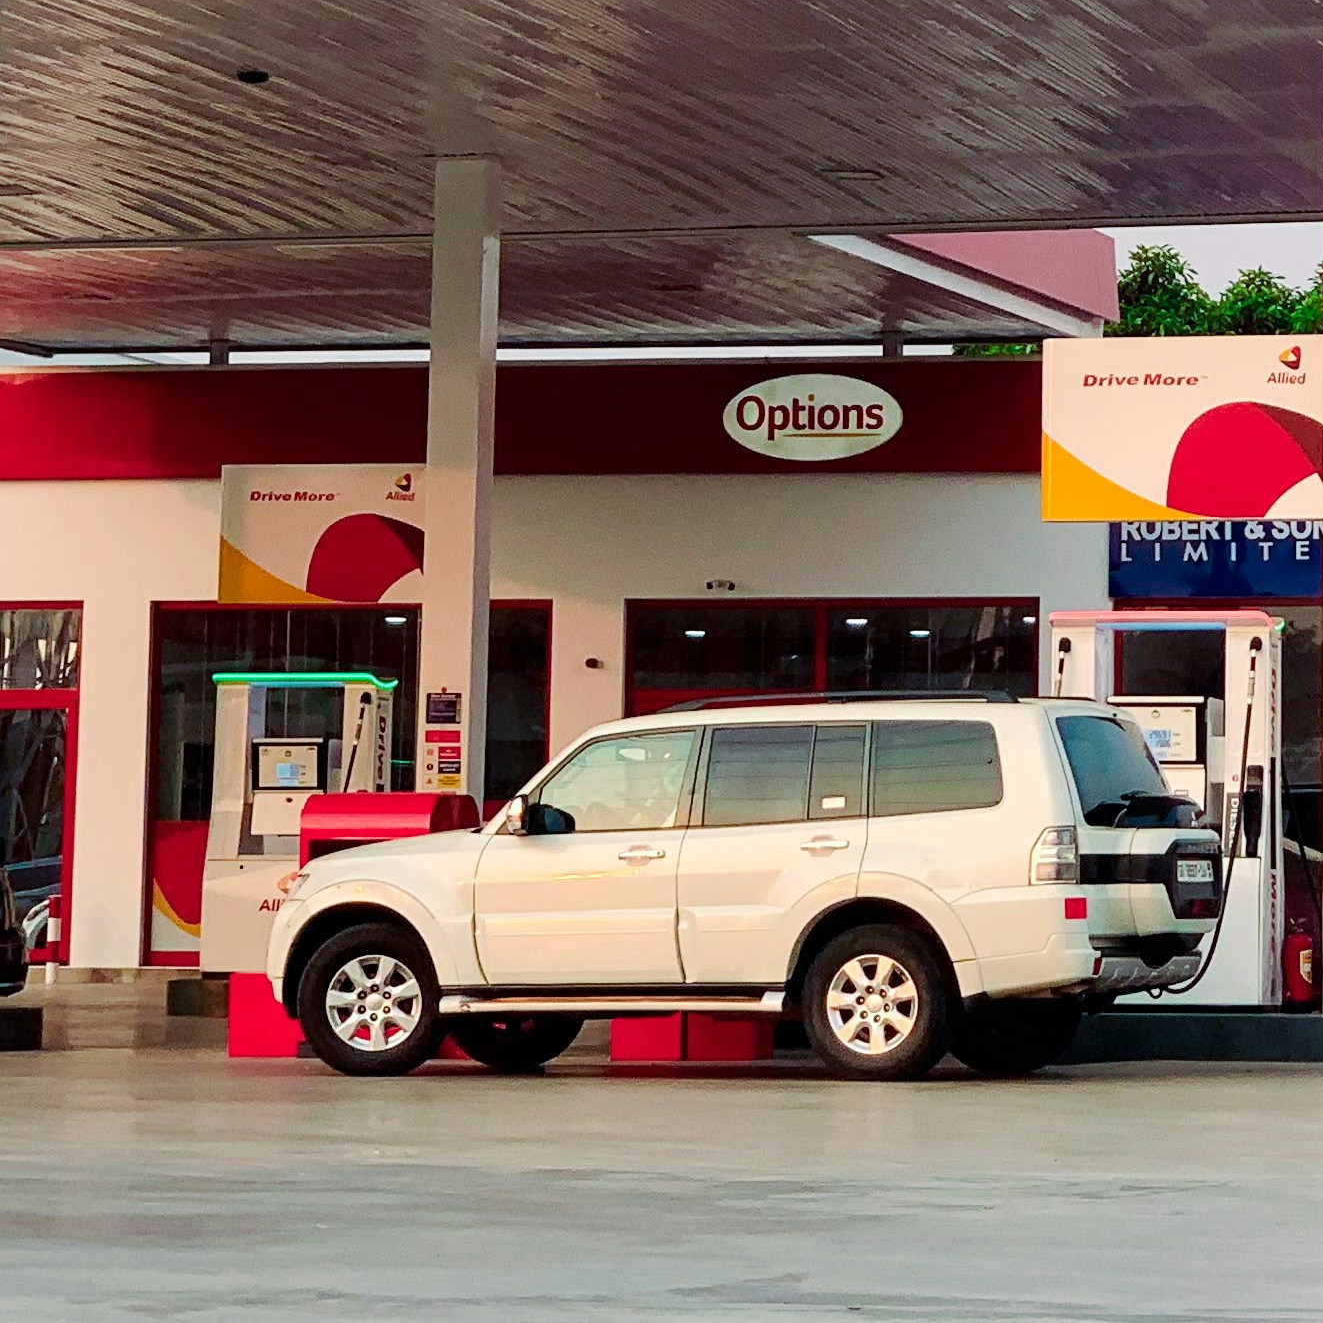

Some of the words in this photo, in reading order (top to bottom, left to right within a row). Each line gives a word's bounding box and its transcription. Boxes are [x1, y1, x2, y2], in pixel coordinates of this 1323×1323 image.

[1083, 373, 1139, 387] Drive
[1143, 372, 1199, 386] More
[1267, 371, 1306, 385] Allied
[736, 393, 884, 442] Options
[249, 490, 291, 502] Drive
[294, 490, 335, 501] More
[386, 491, 415, 502] Allied
[1244, 520, 1266, 541] &
[1120, 541, 1310, 562] LIMITE
[378, 715, 387, 780] Drive
